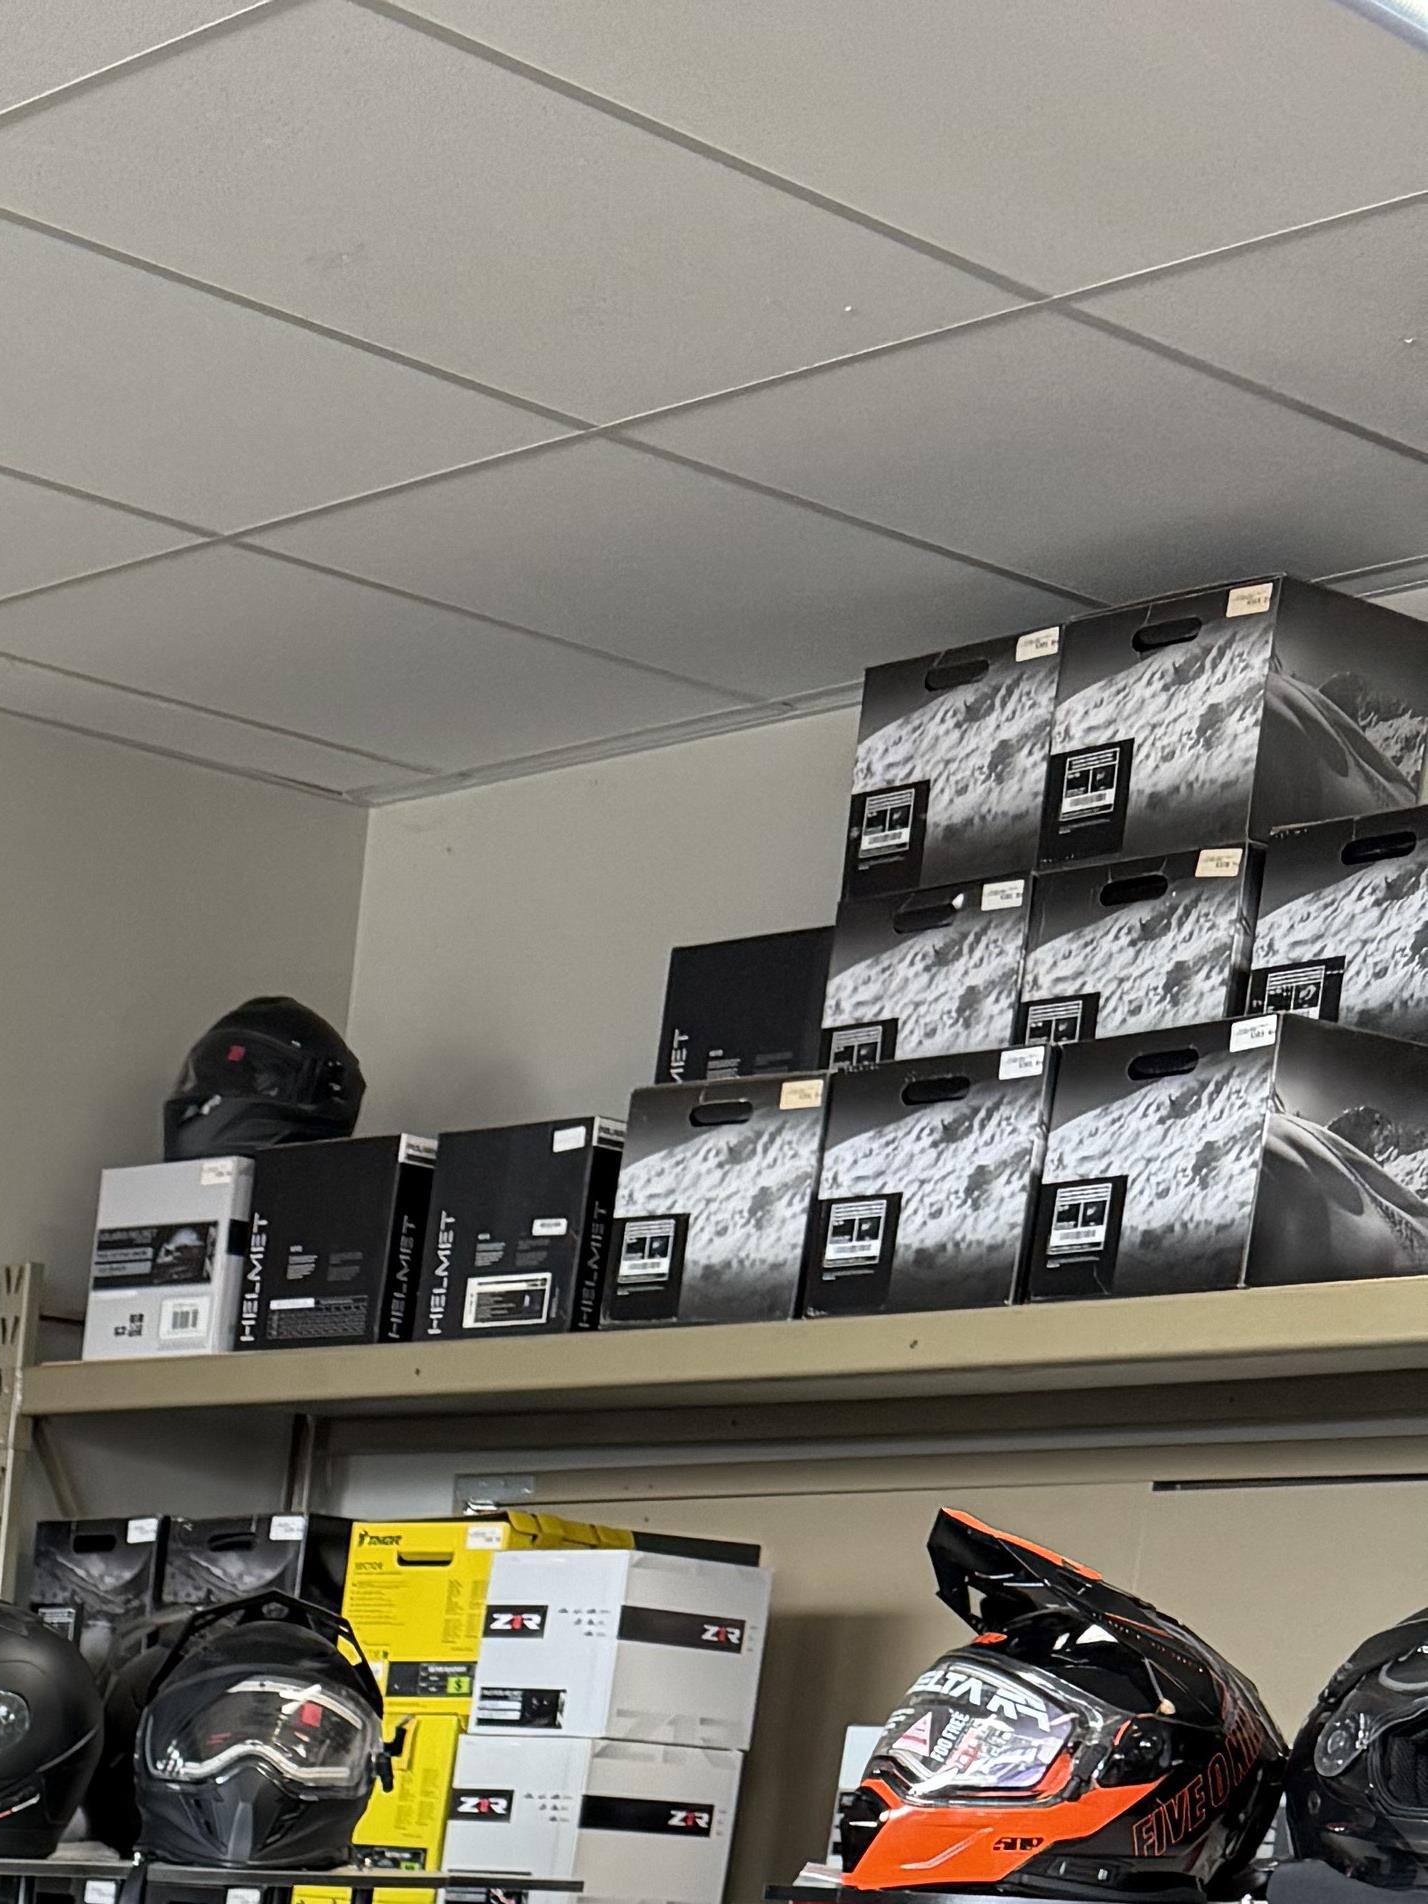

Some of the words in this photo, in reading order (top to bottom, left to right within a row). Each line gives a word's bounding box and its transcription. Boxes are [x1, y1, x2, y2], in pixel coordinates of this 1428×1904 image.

[240, 1212, 269, 1341] HELMET
[388, 1215, 416, 1339] HELMET
[428, 1210, 456, 1335] HELMET
[577, 1201, 608, 1329] HELMET
